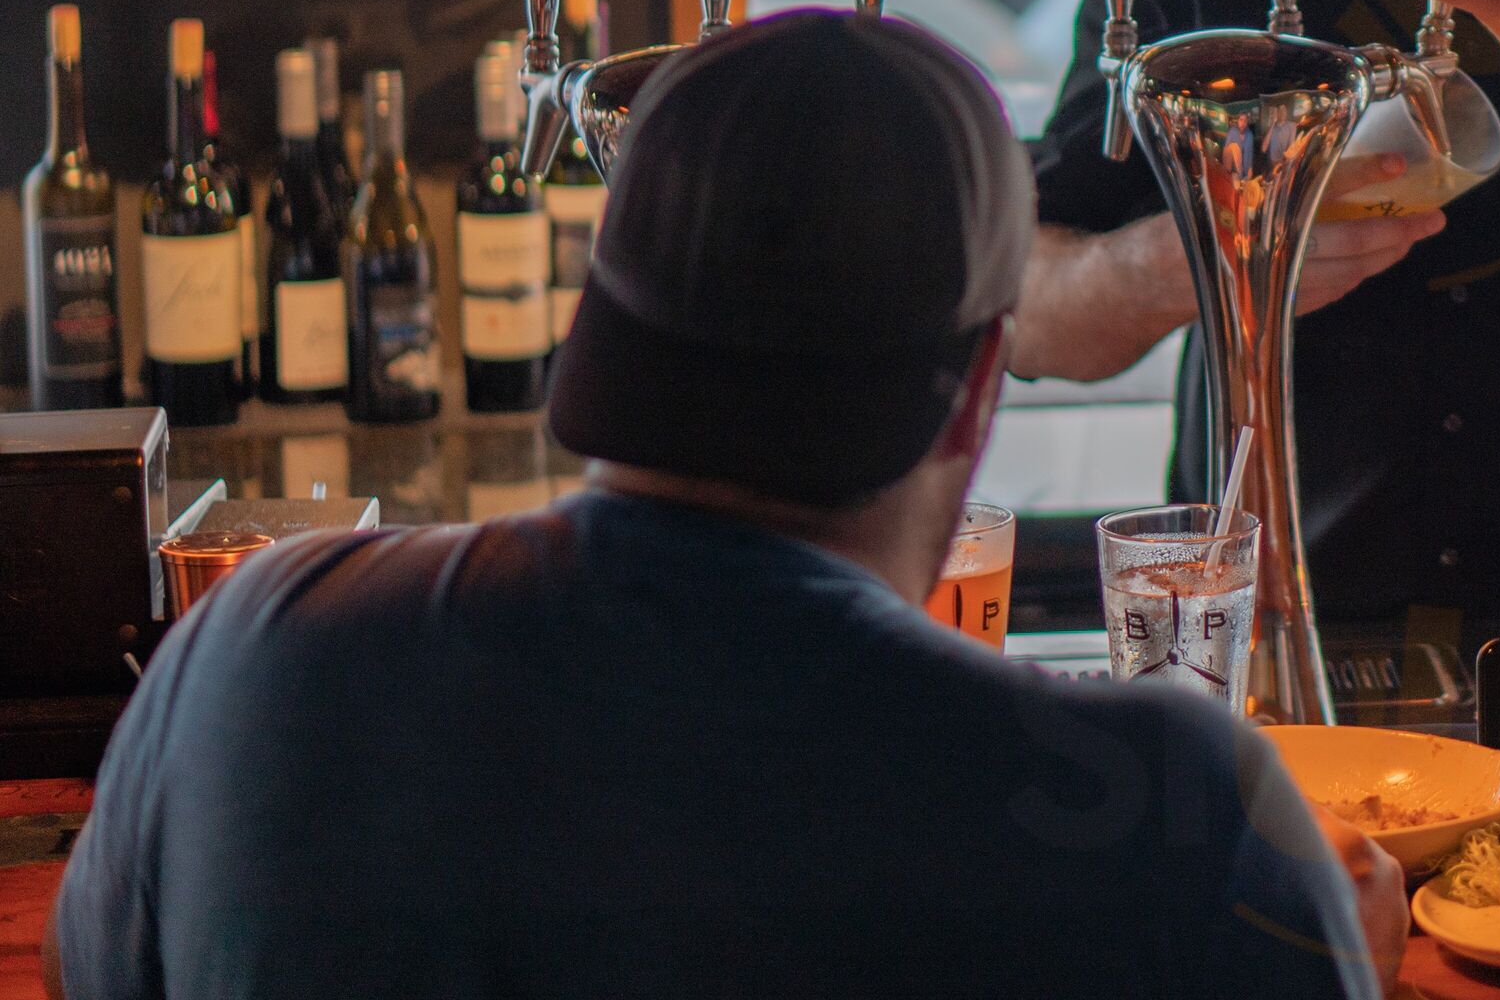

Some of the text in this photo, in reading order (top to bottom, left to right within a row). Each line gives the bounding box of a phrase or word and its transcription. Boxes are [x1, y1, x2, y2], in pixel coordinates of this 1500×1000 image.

[982, 599, 1000, 630] P
[1124, 608, 1228, 640] B P
